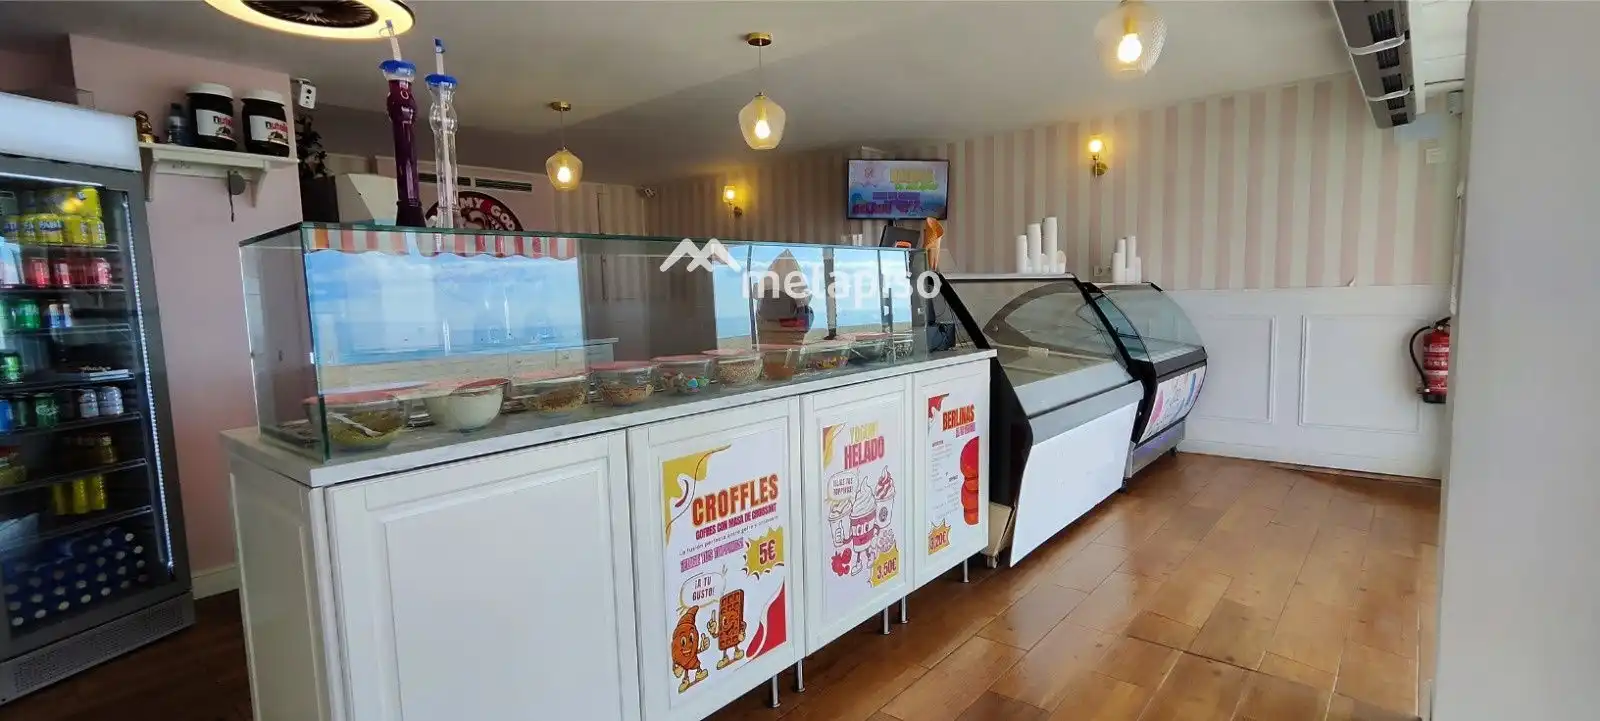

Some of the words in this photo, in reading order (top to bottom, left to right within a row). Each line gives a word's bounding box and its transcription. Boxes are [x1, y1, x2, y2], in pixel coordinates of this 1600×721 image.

[943, 404, 975, 431] BERLINAS
[844, 436, 885, 470] HELADO
[692, 474, 778, 526] CROFFLES
[695, 524, 717, 541] GOFRES
[717, 518, 728, 532] CON
[728, 514, 744, 529] MASA
[744, 511, 752, 523] DE
[759, 539, 776, 565] 5€
[704, 576, 712, 586] TU
[876, 557, 897, 579] 3,50€
[692, 586, 715, 601] GUSTO!
